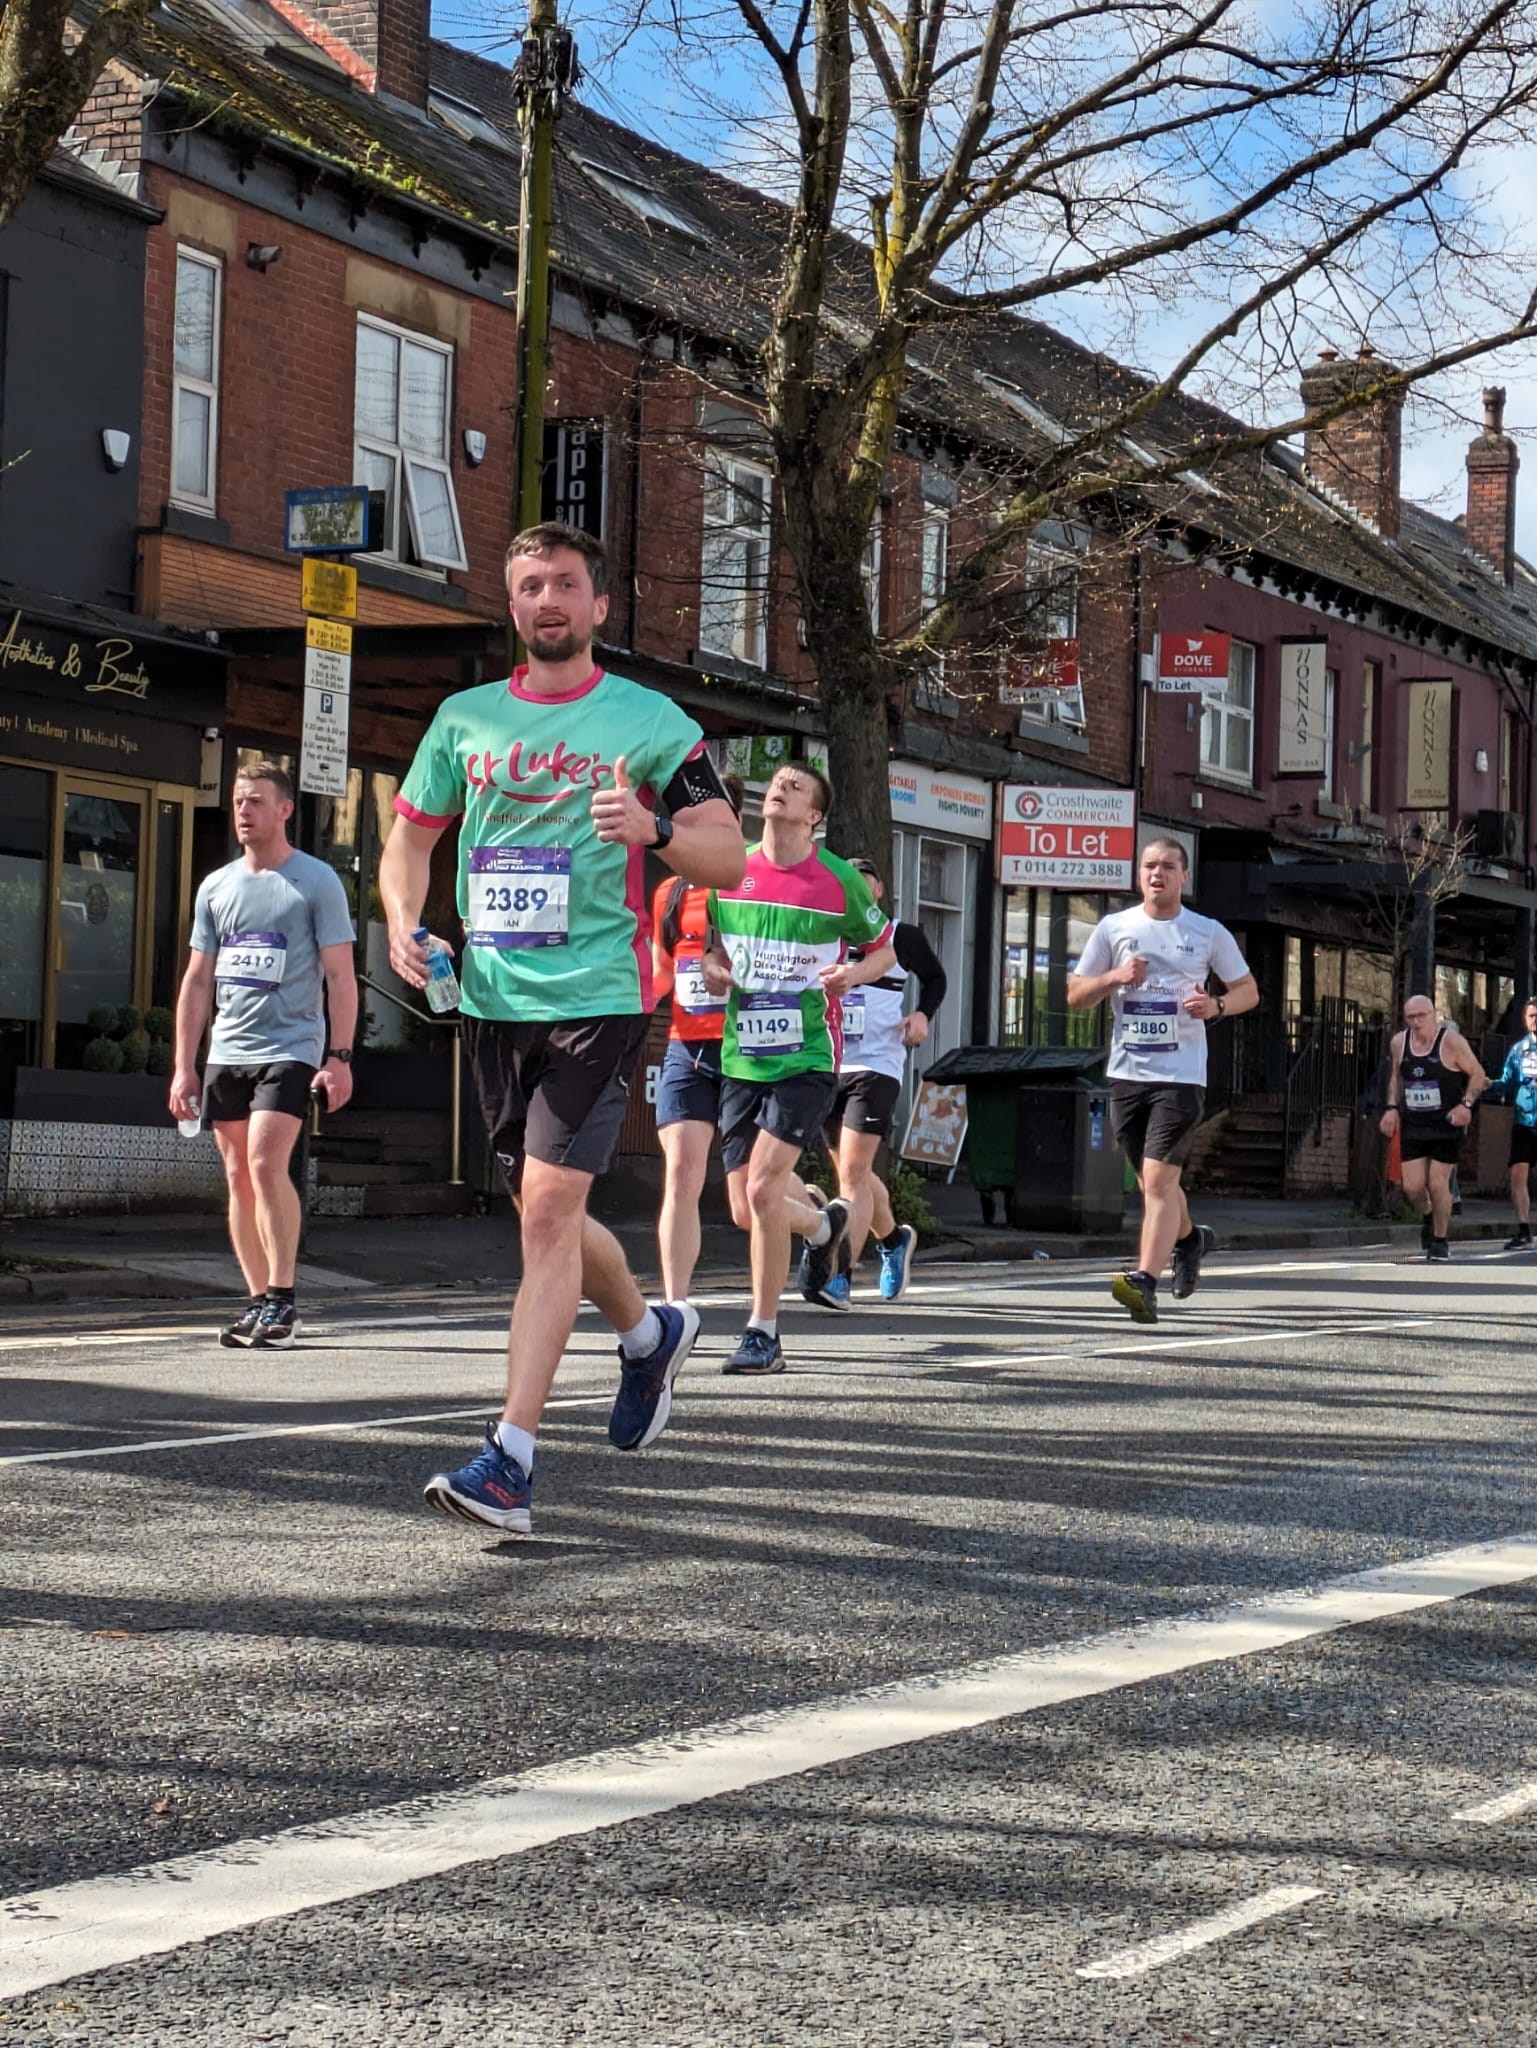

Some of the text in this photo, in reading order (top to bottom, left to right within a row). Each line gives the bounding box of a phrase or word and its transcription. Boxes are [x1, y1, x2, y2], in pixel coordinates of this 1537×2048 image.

[0, 609, 150, 699] Aesthetics & Beauty
[1174, 655, 1213, 666] DOVE
[1159, 680, 1191, 690] To Let
[323, 695, 332, 712] P
[26, 717, 69, 742] Academy
[81, 728, 118, 749] Medical
[120, 735, 139, 754] Spa
[508, 741, 611, 790] Luke's
[1047, 792, 1123, 809] Crosthwaite
[938, 800, 985, 819] FIGHTS POVERTY
[1047, 809, 1121, 822] COMMERCIAL
[536, 812, 581, 826] Hospice
[1024, 825, 1109, 857] To Let
[1013, 860, 1122, 877] T 0114 272 3888
[486, 887, 549, 912] 2389
[504, 919, 520, 928] IAN
[231, 954, 275, 969] 2419
[748, 1017, 789, 1034] 1149
[1132, 1022, 1168, 1034] 3880
